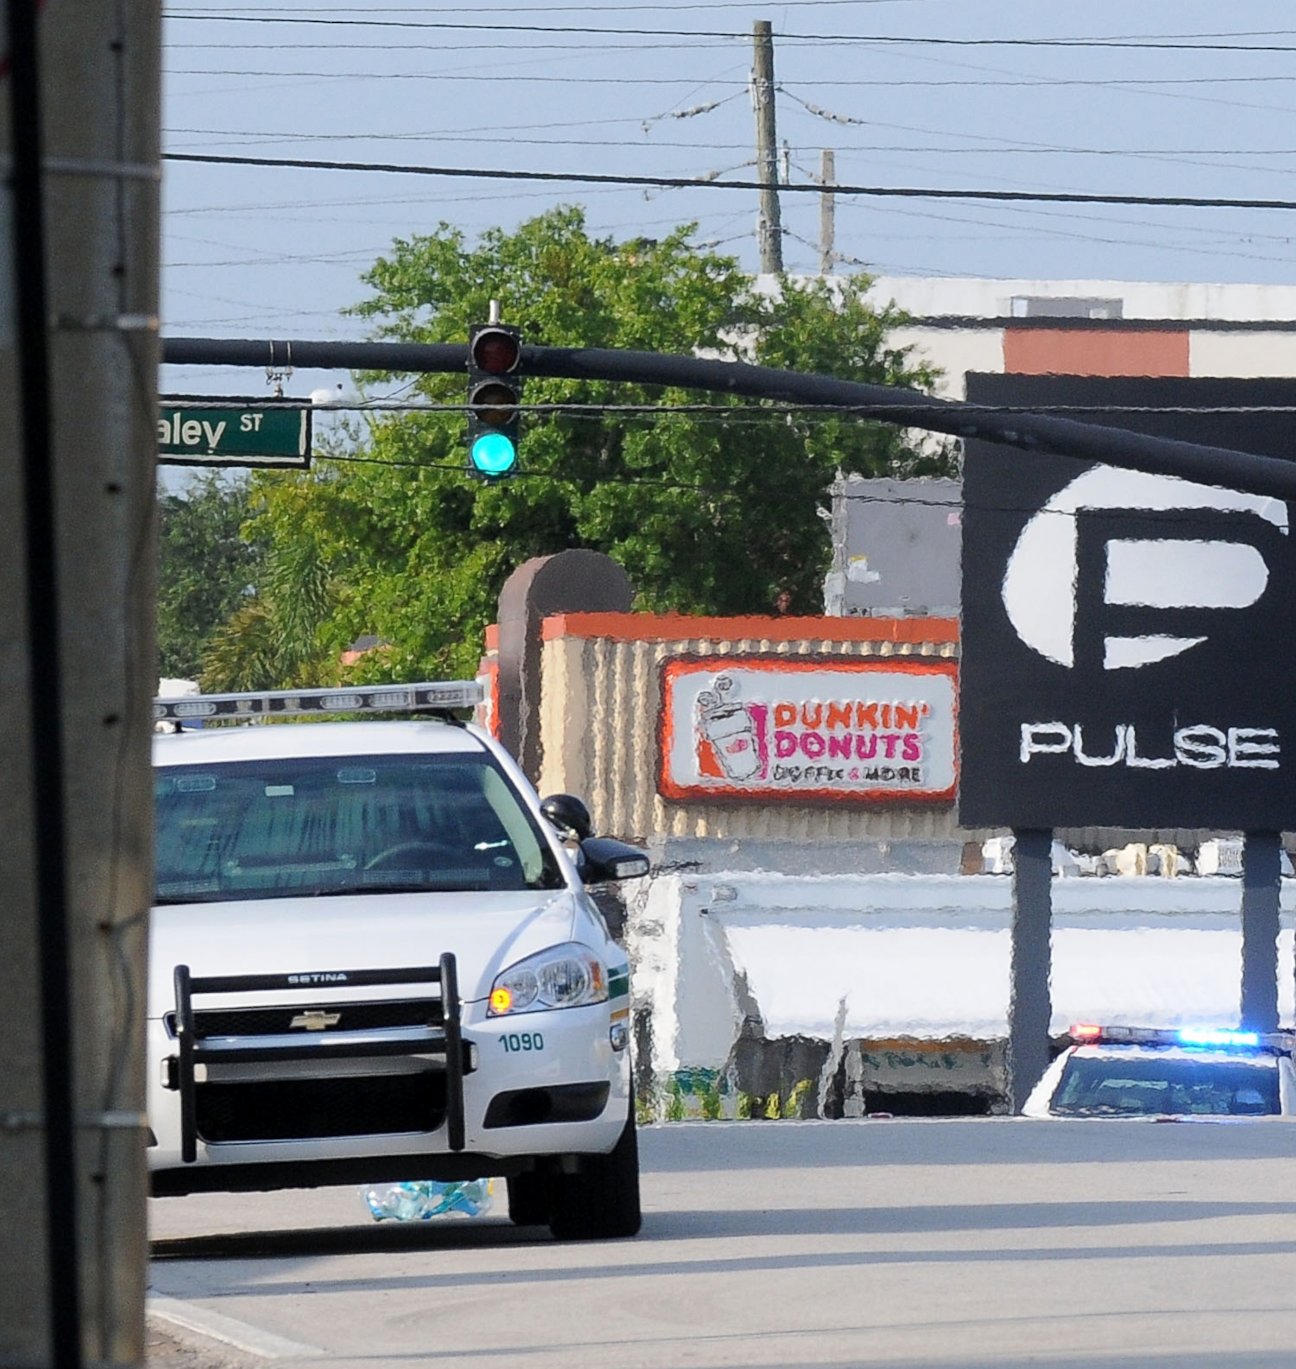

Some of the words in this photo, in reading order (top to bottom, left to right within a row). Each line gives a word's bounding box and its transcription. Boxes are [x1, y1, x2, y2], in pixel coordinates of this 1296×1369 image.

[157, 412, 226, 453] aley
[240, 413, 264, 432] ST
[774, 701, 929, 730] DUNKIN'
[774, 730, 921, 761] DONUTS
[1020, 721, 1280, 769] PULSE
[864, 766, 921, 782] MORE
[287, 973, 347, 984] SETINA
[498, 1032, 544, 1053] 1090
